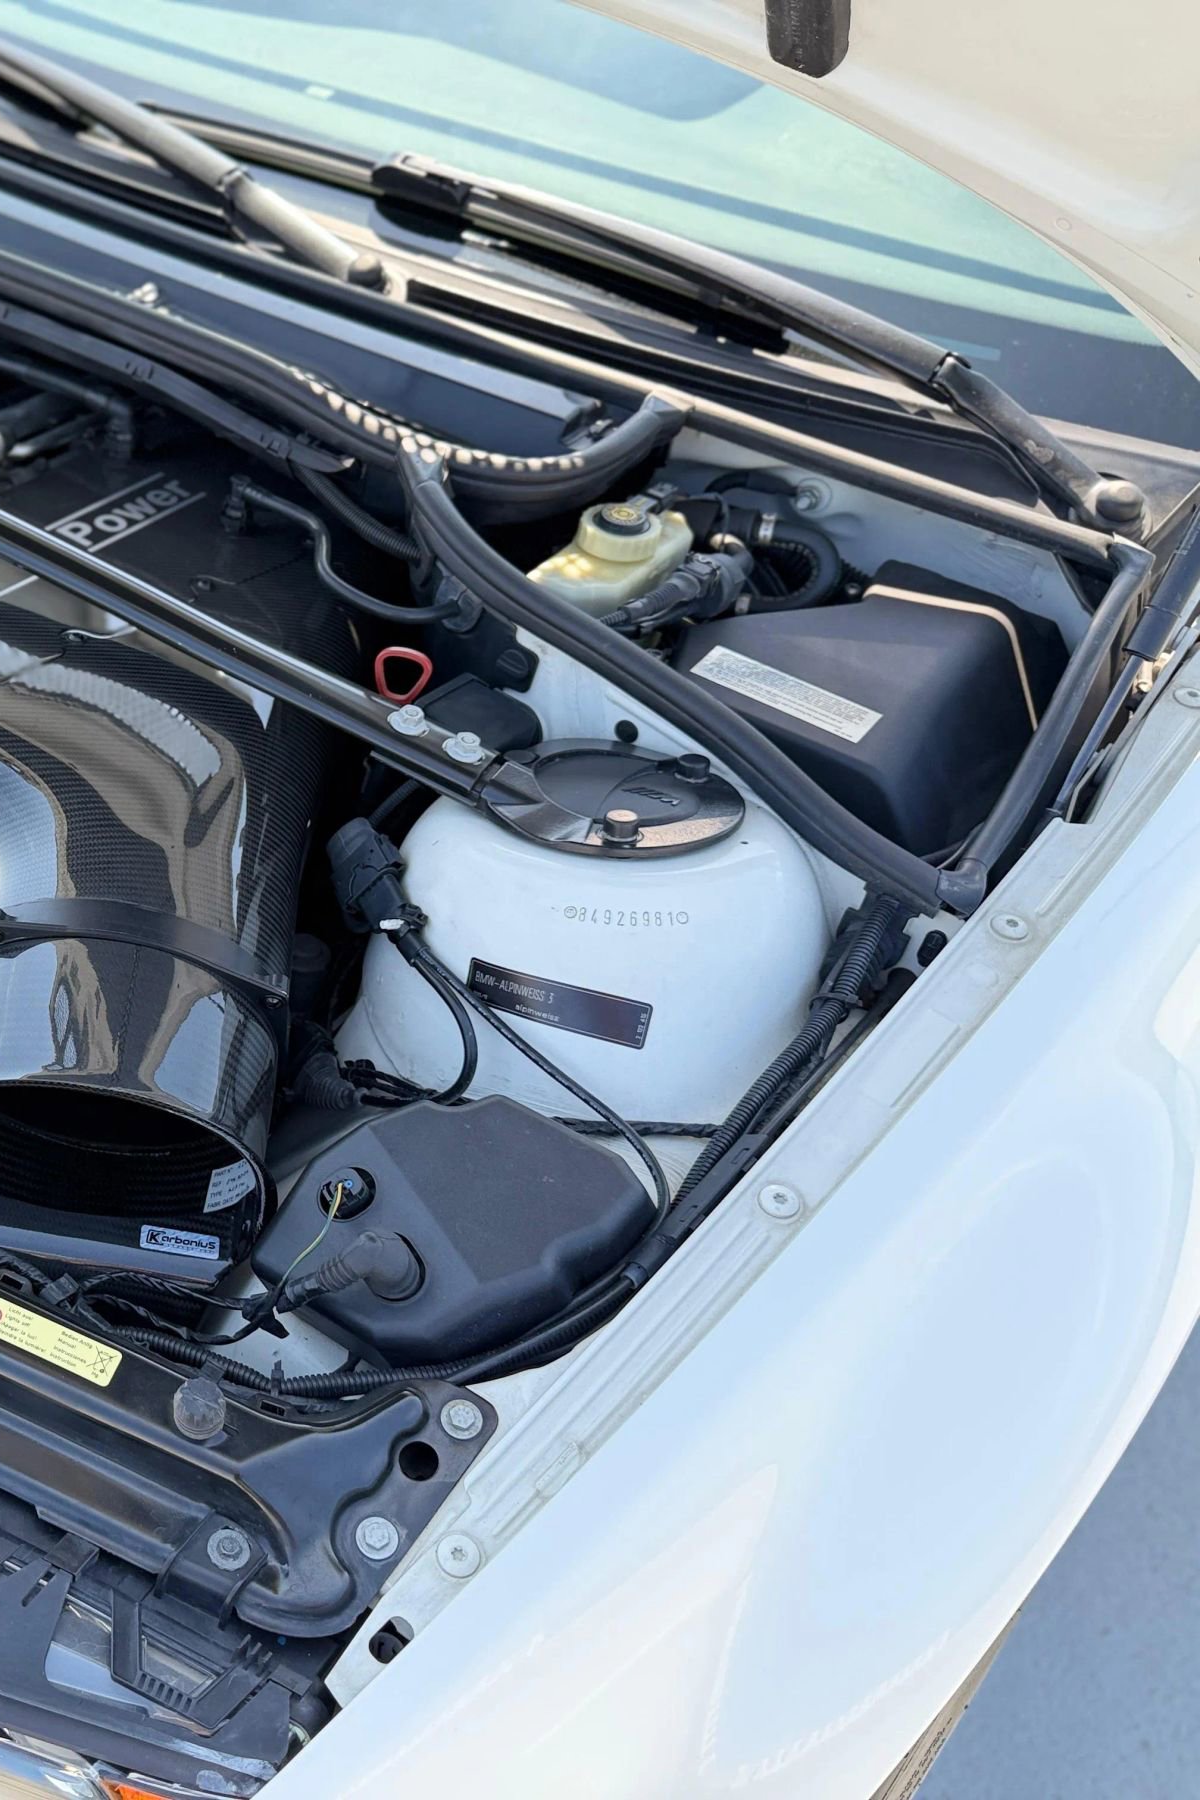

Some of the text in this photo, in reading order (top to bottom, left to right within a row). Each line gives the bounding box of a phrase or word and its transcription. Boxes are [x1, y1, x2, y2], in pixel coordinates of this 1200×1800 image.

[55, 479, 192, 547] Power
[475, 971, 545, 1001] BMW-ALPINWEISS
[149, 1231, 216, 1250] Karbonius
